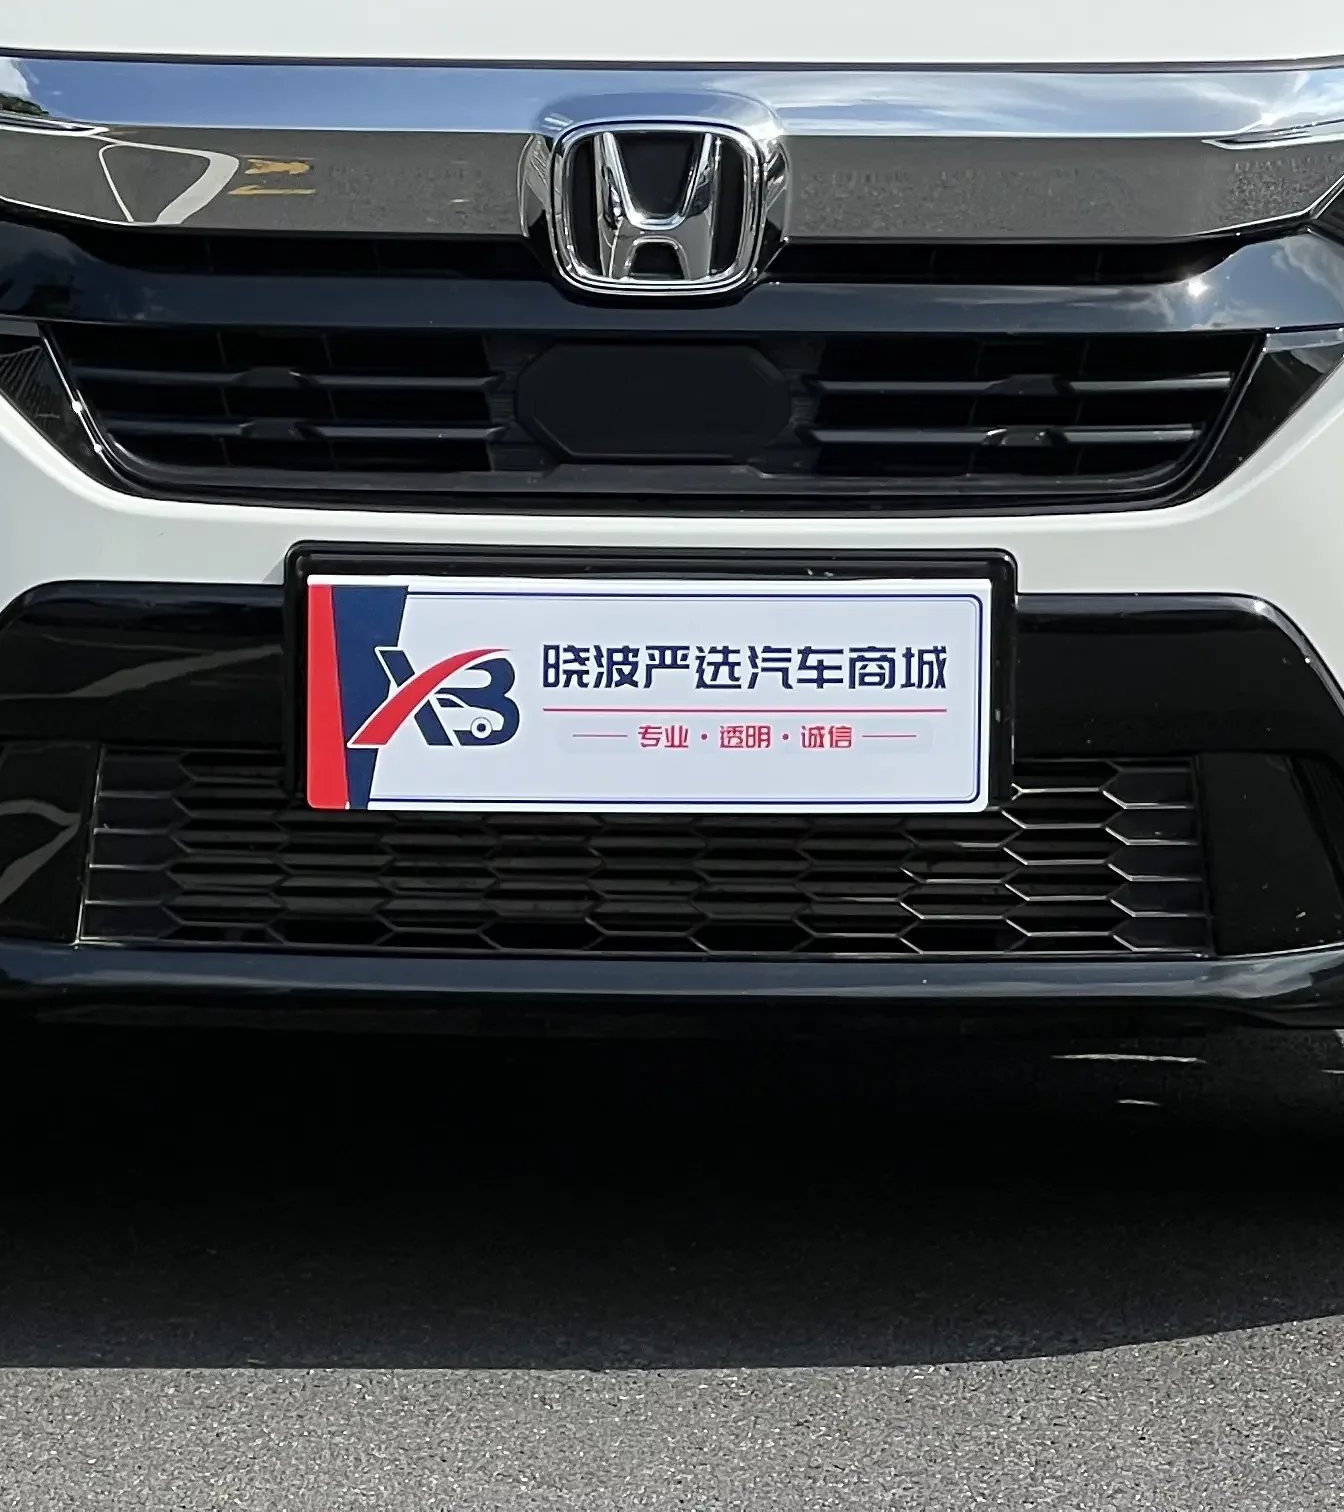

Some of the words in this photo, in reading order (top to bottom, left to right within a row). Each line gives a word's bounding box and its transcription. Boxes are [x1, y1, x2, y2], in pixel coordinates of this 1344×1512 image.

[542, 643, 948, 690] 晓波严选汽车商城
